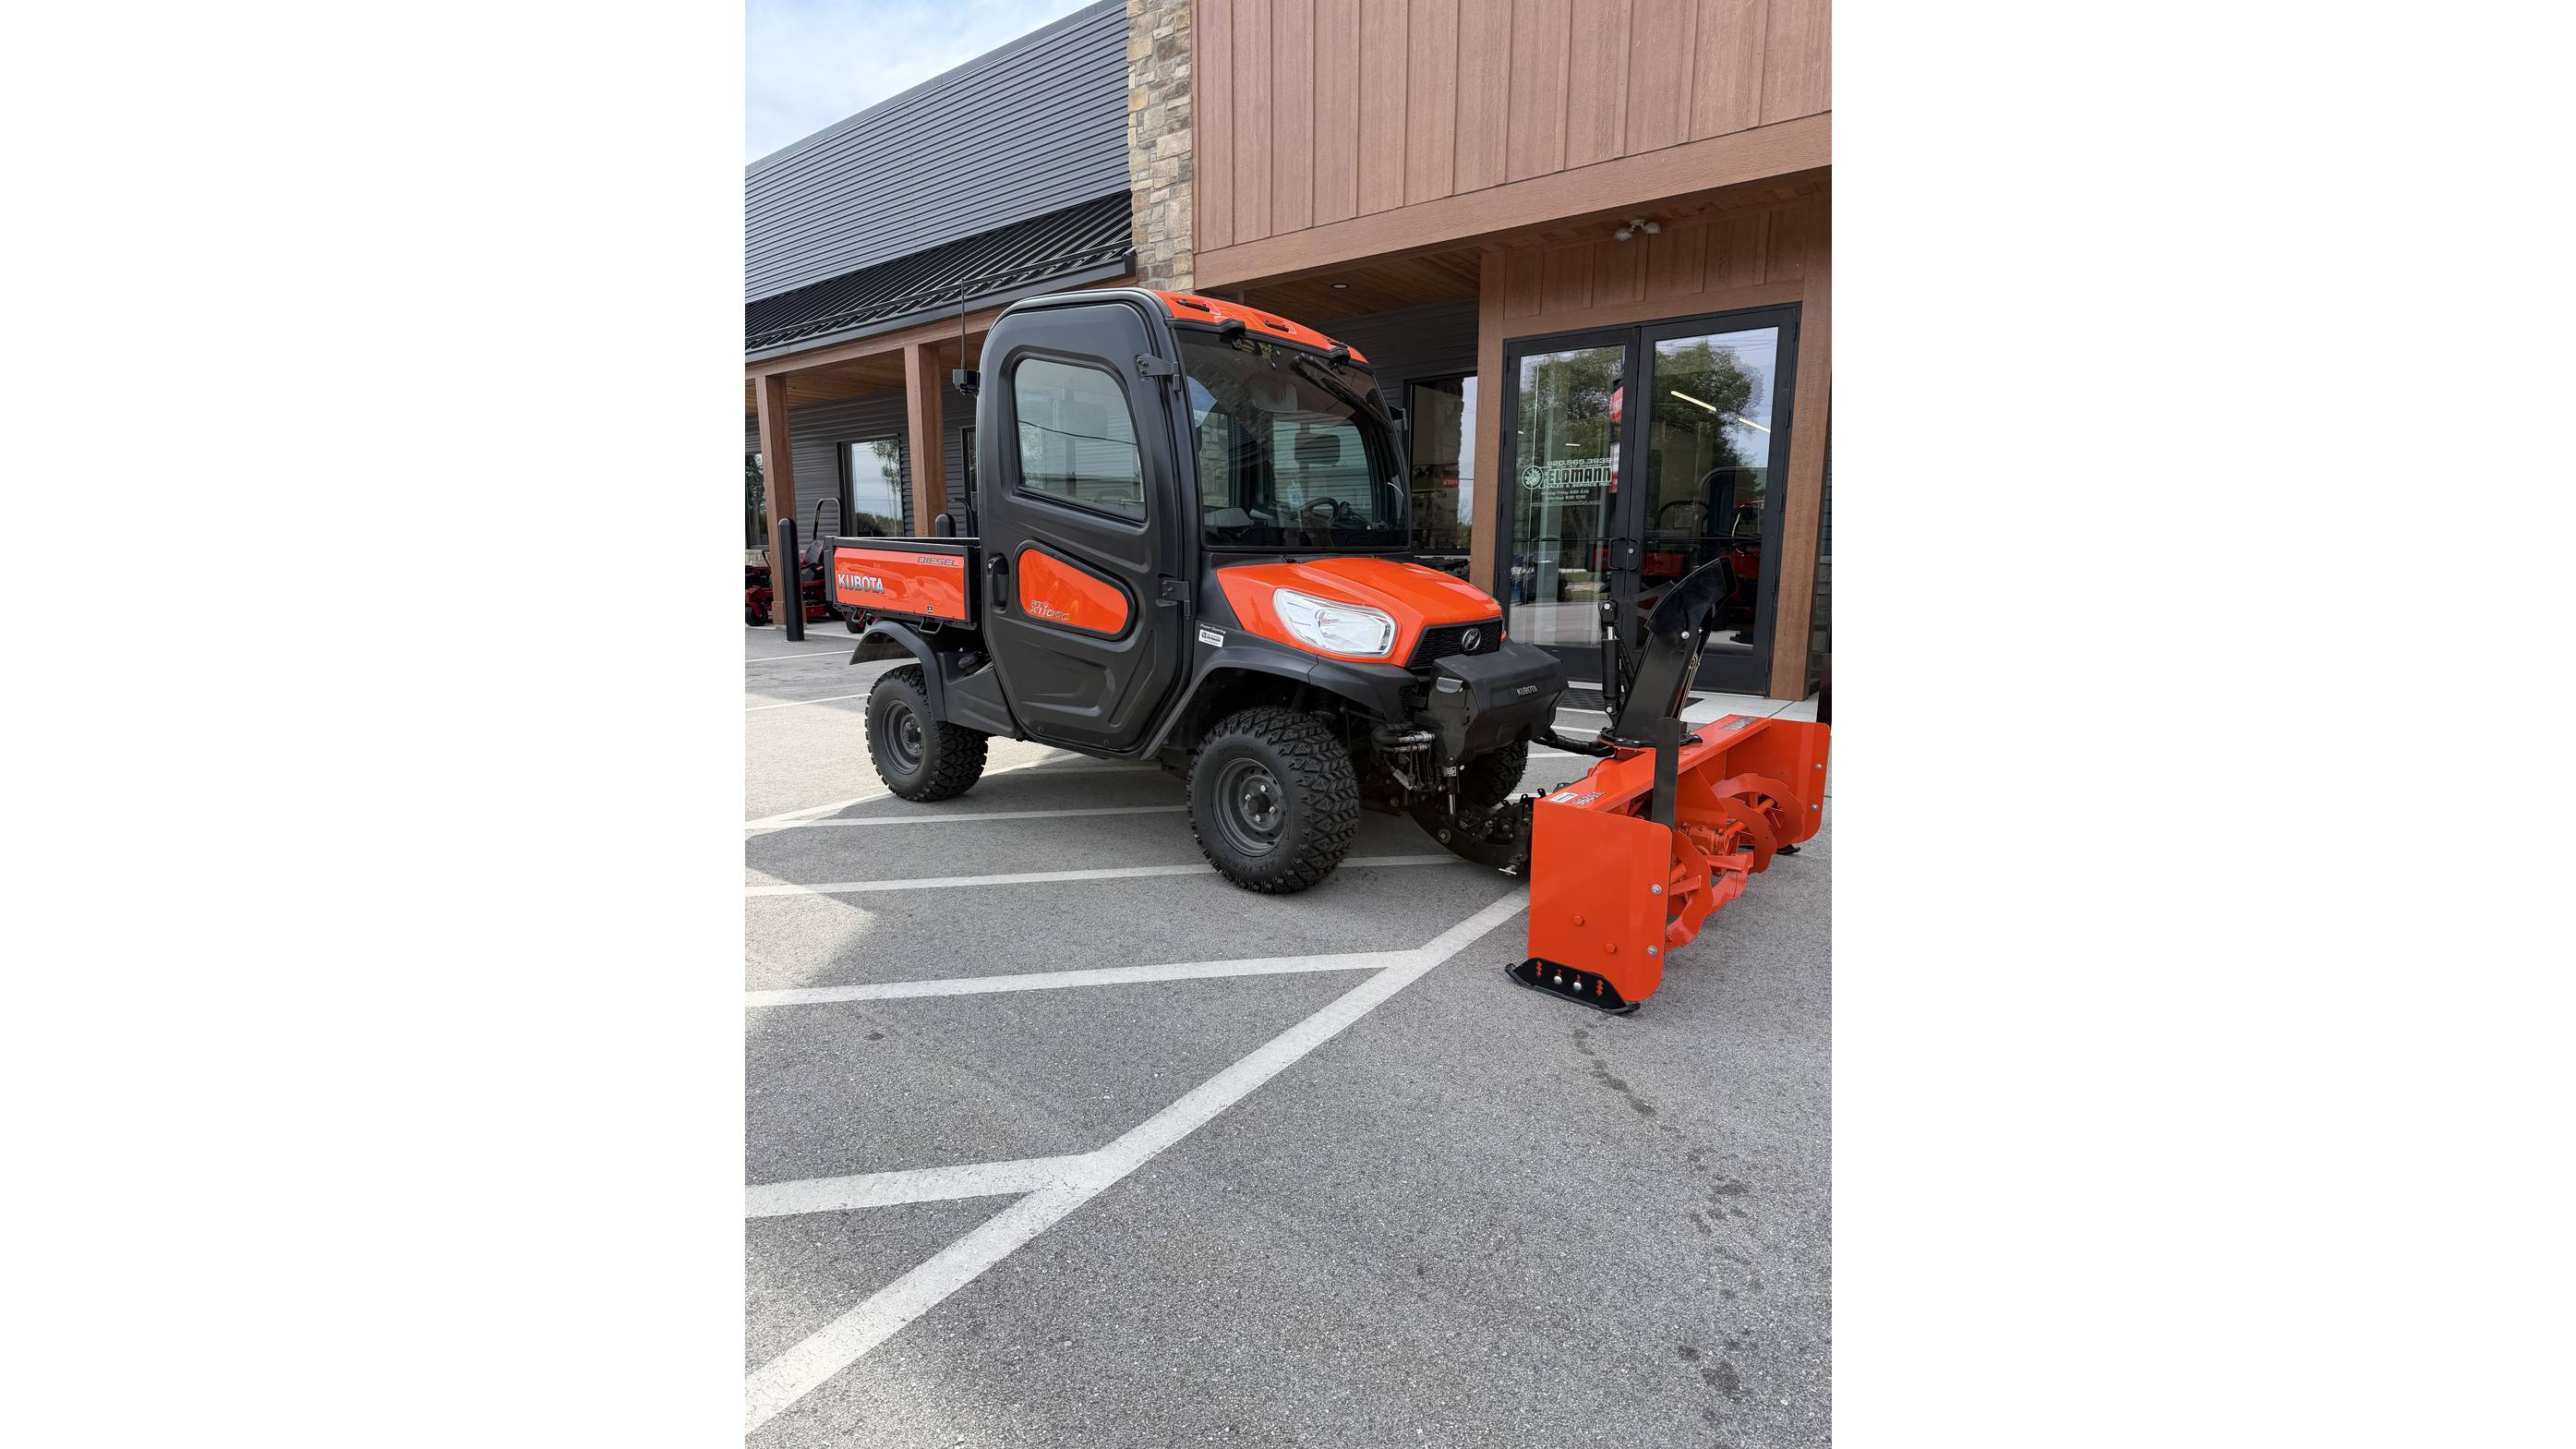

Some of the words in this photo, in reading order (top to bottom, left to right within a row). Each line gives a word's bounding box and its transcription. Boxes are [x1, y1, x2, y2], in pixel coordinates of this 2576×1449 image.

[917, 556, 959, 567] DIESEL
[837, 574, 885, 594] KUBOTA
[1516, 684, 1538, 695] KUBOTA
